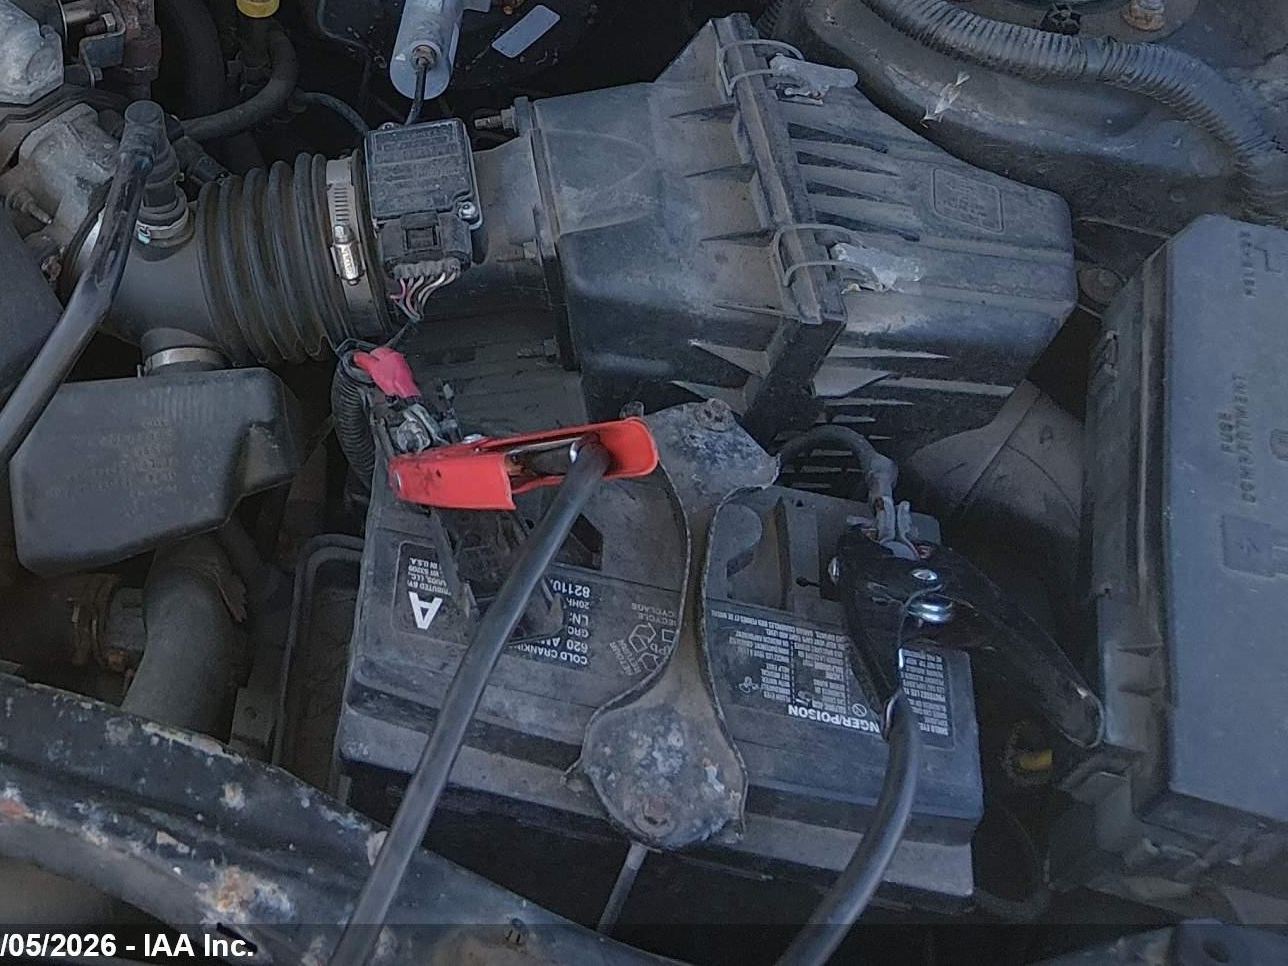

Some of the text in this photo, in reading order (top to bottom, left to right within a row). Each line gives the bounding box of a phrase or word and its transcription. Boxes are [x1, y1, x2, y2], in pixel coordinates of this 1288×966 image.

[1218, 412, 1233, 454] FUSE
[1231, 372, 1257, 505] COMPARTMENT
[408, 590, 443, 630] A
[561, 652, 588, 665] COLD
[566, 639, 588, 653] 620
